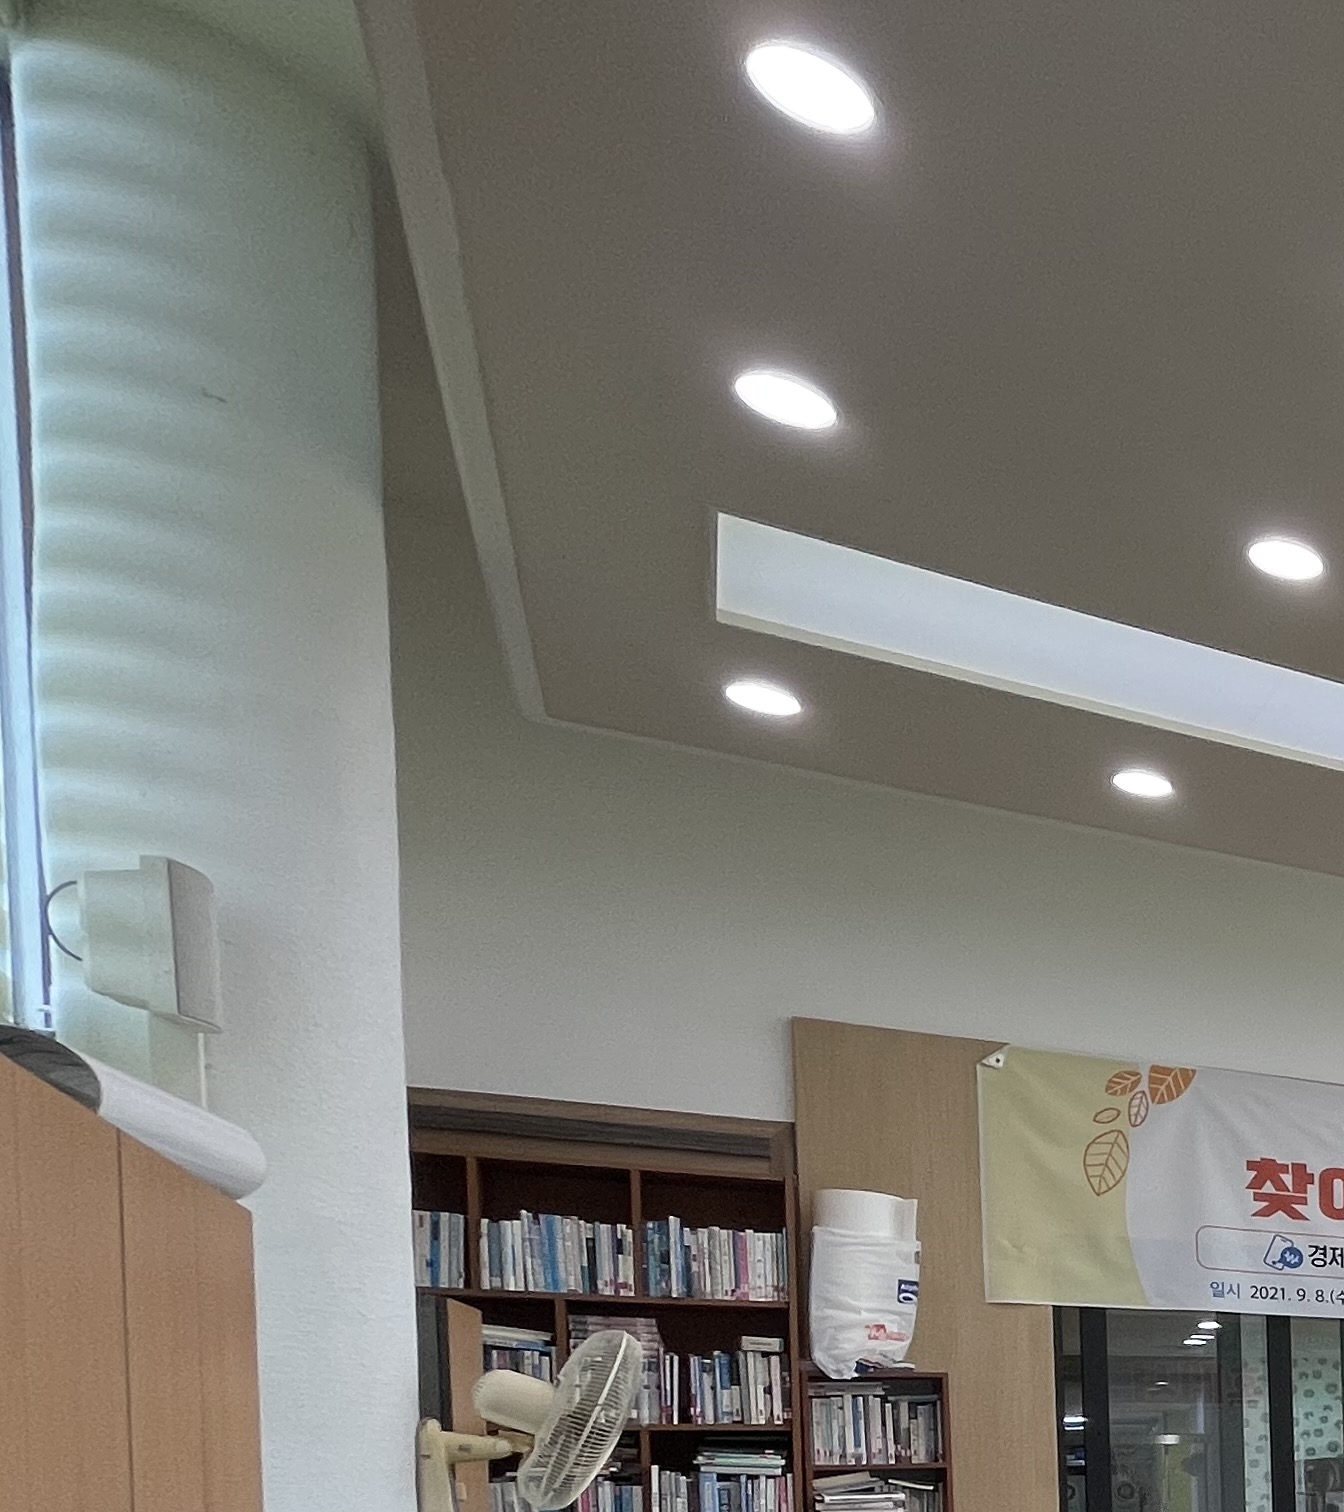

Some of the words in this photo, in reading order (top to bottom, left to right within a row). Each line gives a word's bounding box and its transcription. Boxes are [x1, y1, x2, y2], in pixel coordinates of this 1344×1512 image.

[1210, 1281, 1240, 1299] 일시
[1249, 1285, 1292, 1301] 2021.
[1296, 1287, 1311, 1302] 9.
